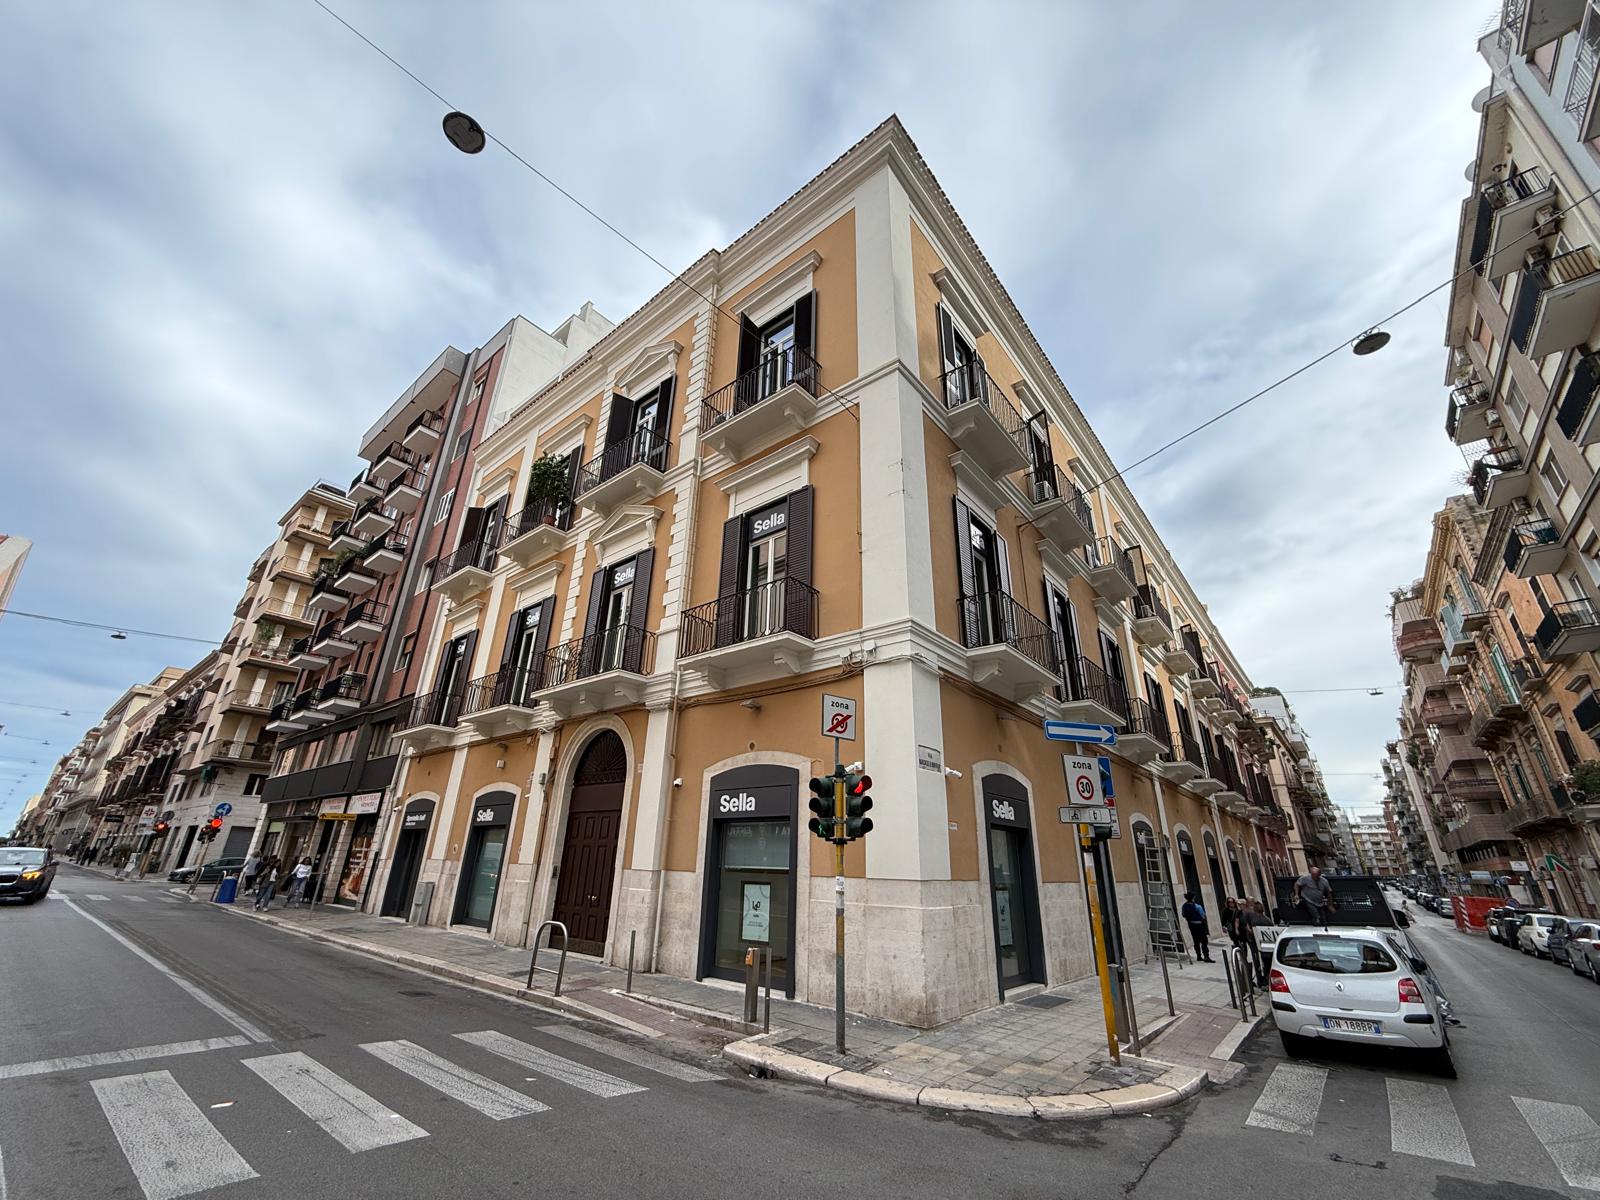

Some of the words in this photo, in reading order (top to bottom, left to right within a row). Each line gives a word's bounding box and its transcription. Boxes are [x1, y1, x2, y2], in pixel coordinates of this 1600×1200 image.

[753, 512, 785, 534] Sella
[613, 567, 635, 584] Sella
[831, 701, 849, 710] zona
[1071, 761, 1092, 770] zona
[1079, 781, 1091, 794] 30
[719, 792, 756, 813] Sella
[476, 808, 494, 822] Sella
[992, 799, 1015, 821] Sella
[1328, 1018, 1341, 1030] DN
